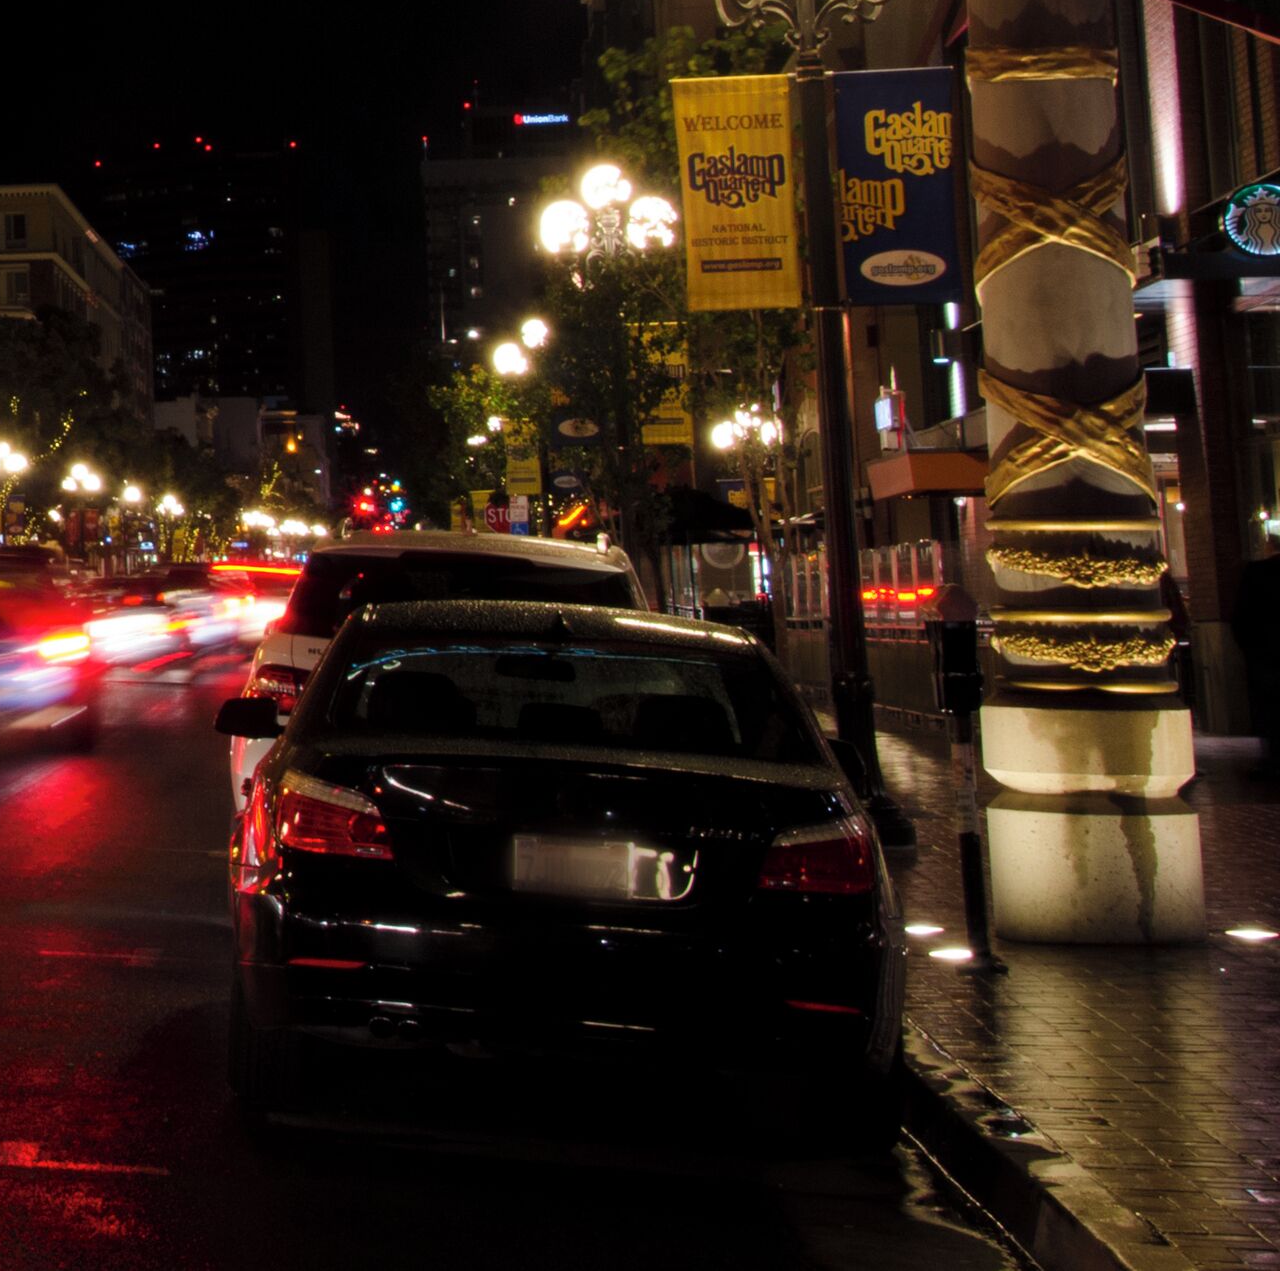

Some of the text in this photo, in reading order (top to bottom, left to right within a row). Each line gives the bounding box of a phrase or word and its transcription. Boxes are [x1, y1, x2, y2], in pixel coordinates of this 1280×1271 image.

[522, 113, 569, 125] UnionBank
[683, 112, 784, 133] WELCOME
[687, 144, 785, 199] Gaslamp
[704, 177, 771, 209] Quarter
[711, 223, 766, 234] NATIONAL
[691, 234, 788, 248] HISTORIC DISTRICT
[871, 263, 936, 277] gaslamp.org
